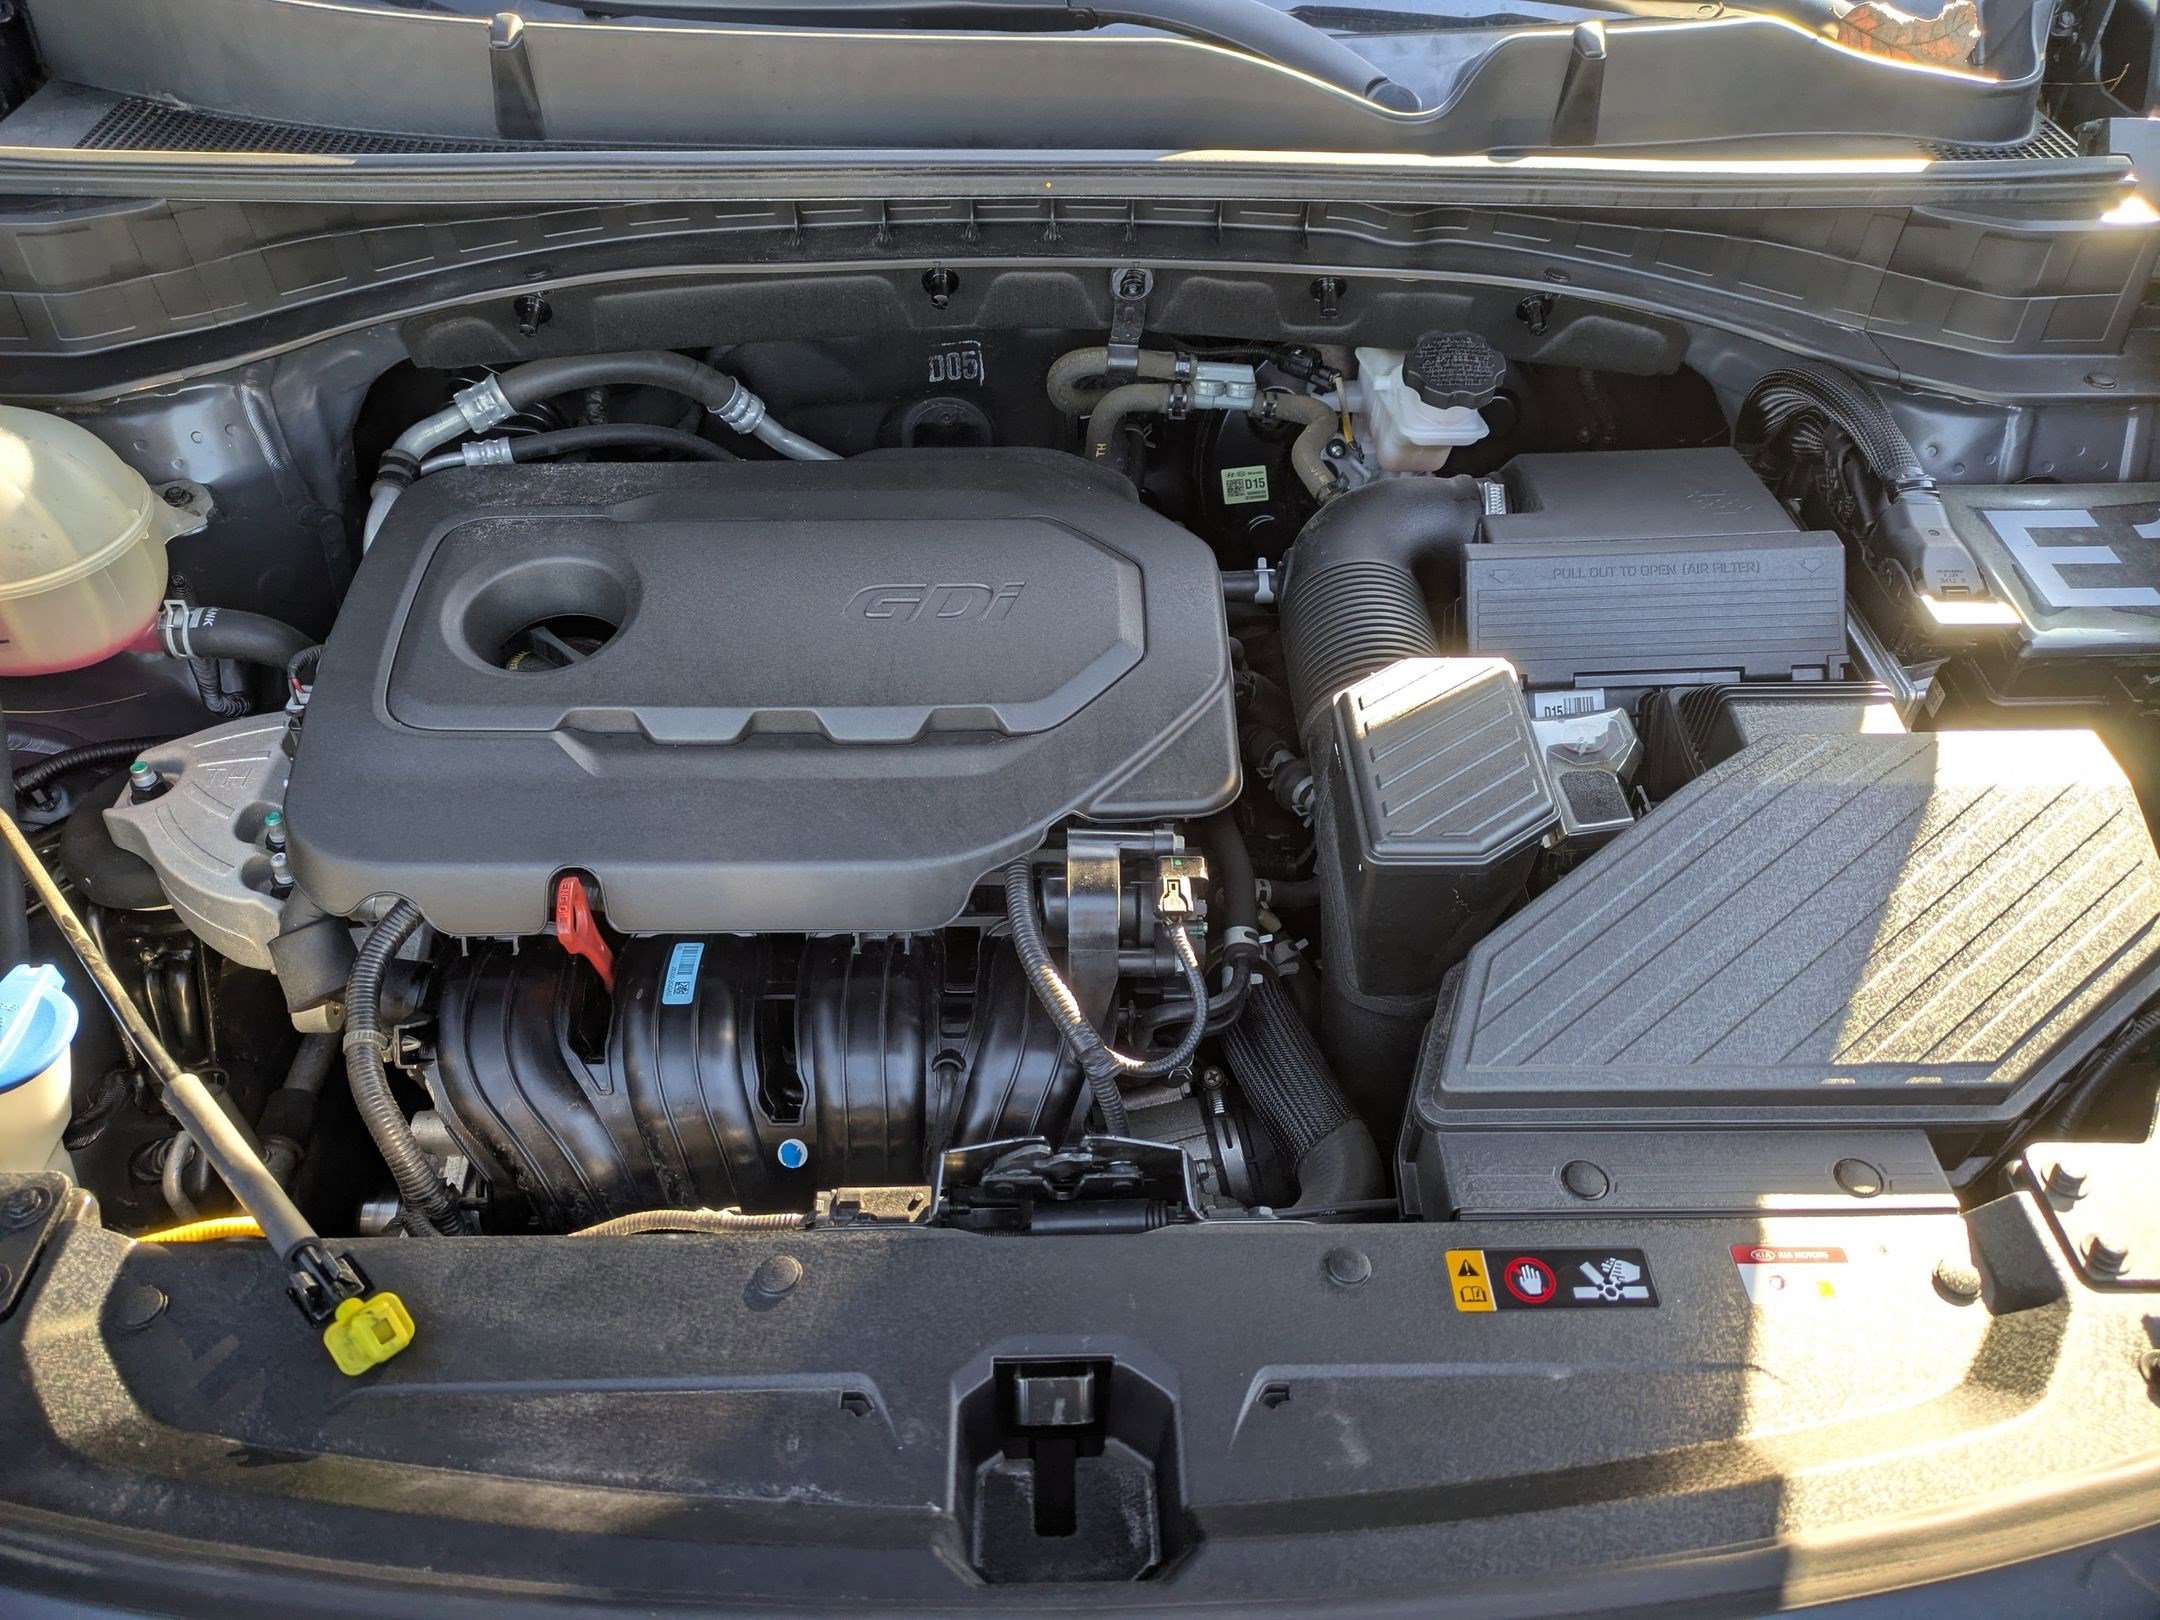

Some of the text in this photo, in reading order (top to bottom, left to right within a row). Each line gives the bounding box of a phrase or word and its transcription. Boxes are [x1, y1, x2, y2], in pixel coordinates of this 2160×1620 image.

[1244, 478, 1266, 490] D15
[1553, 567, 1586, 579] PULL
[1589, 566, 1616, 578] OUT
[1618, 565, 1637, 577] TO
[843, 581, 1027, 624] GDi
[1752, 1249, 1775, 1260] KIA
